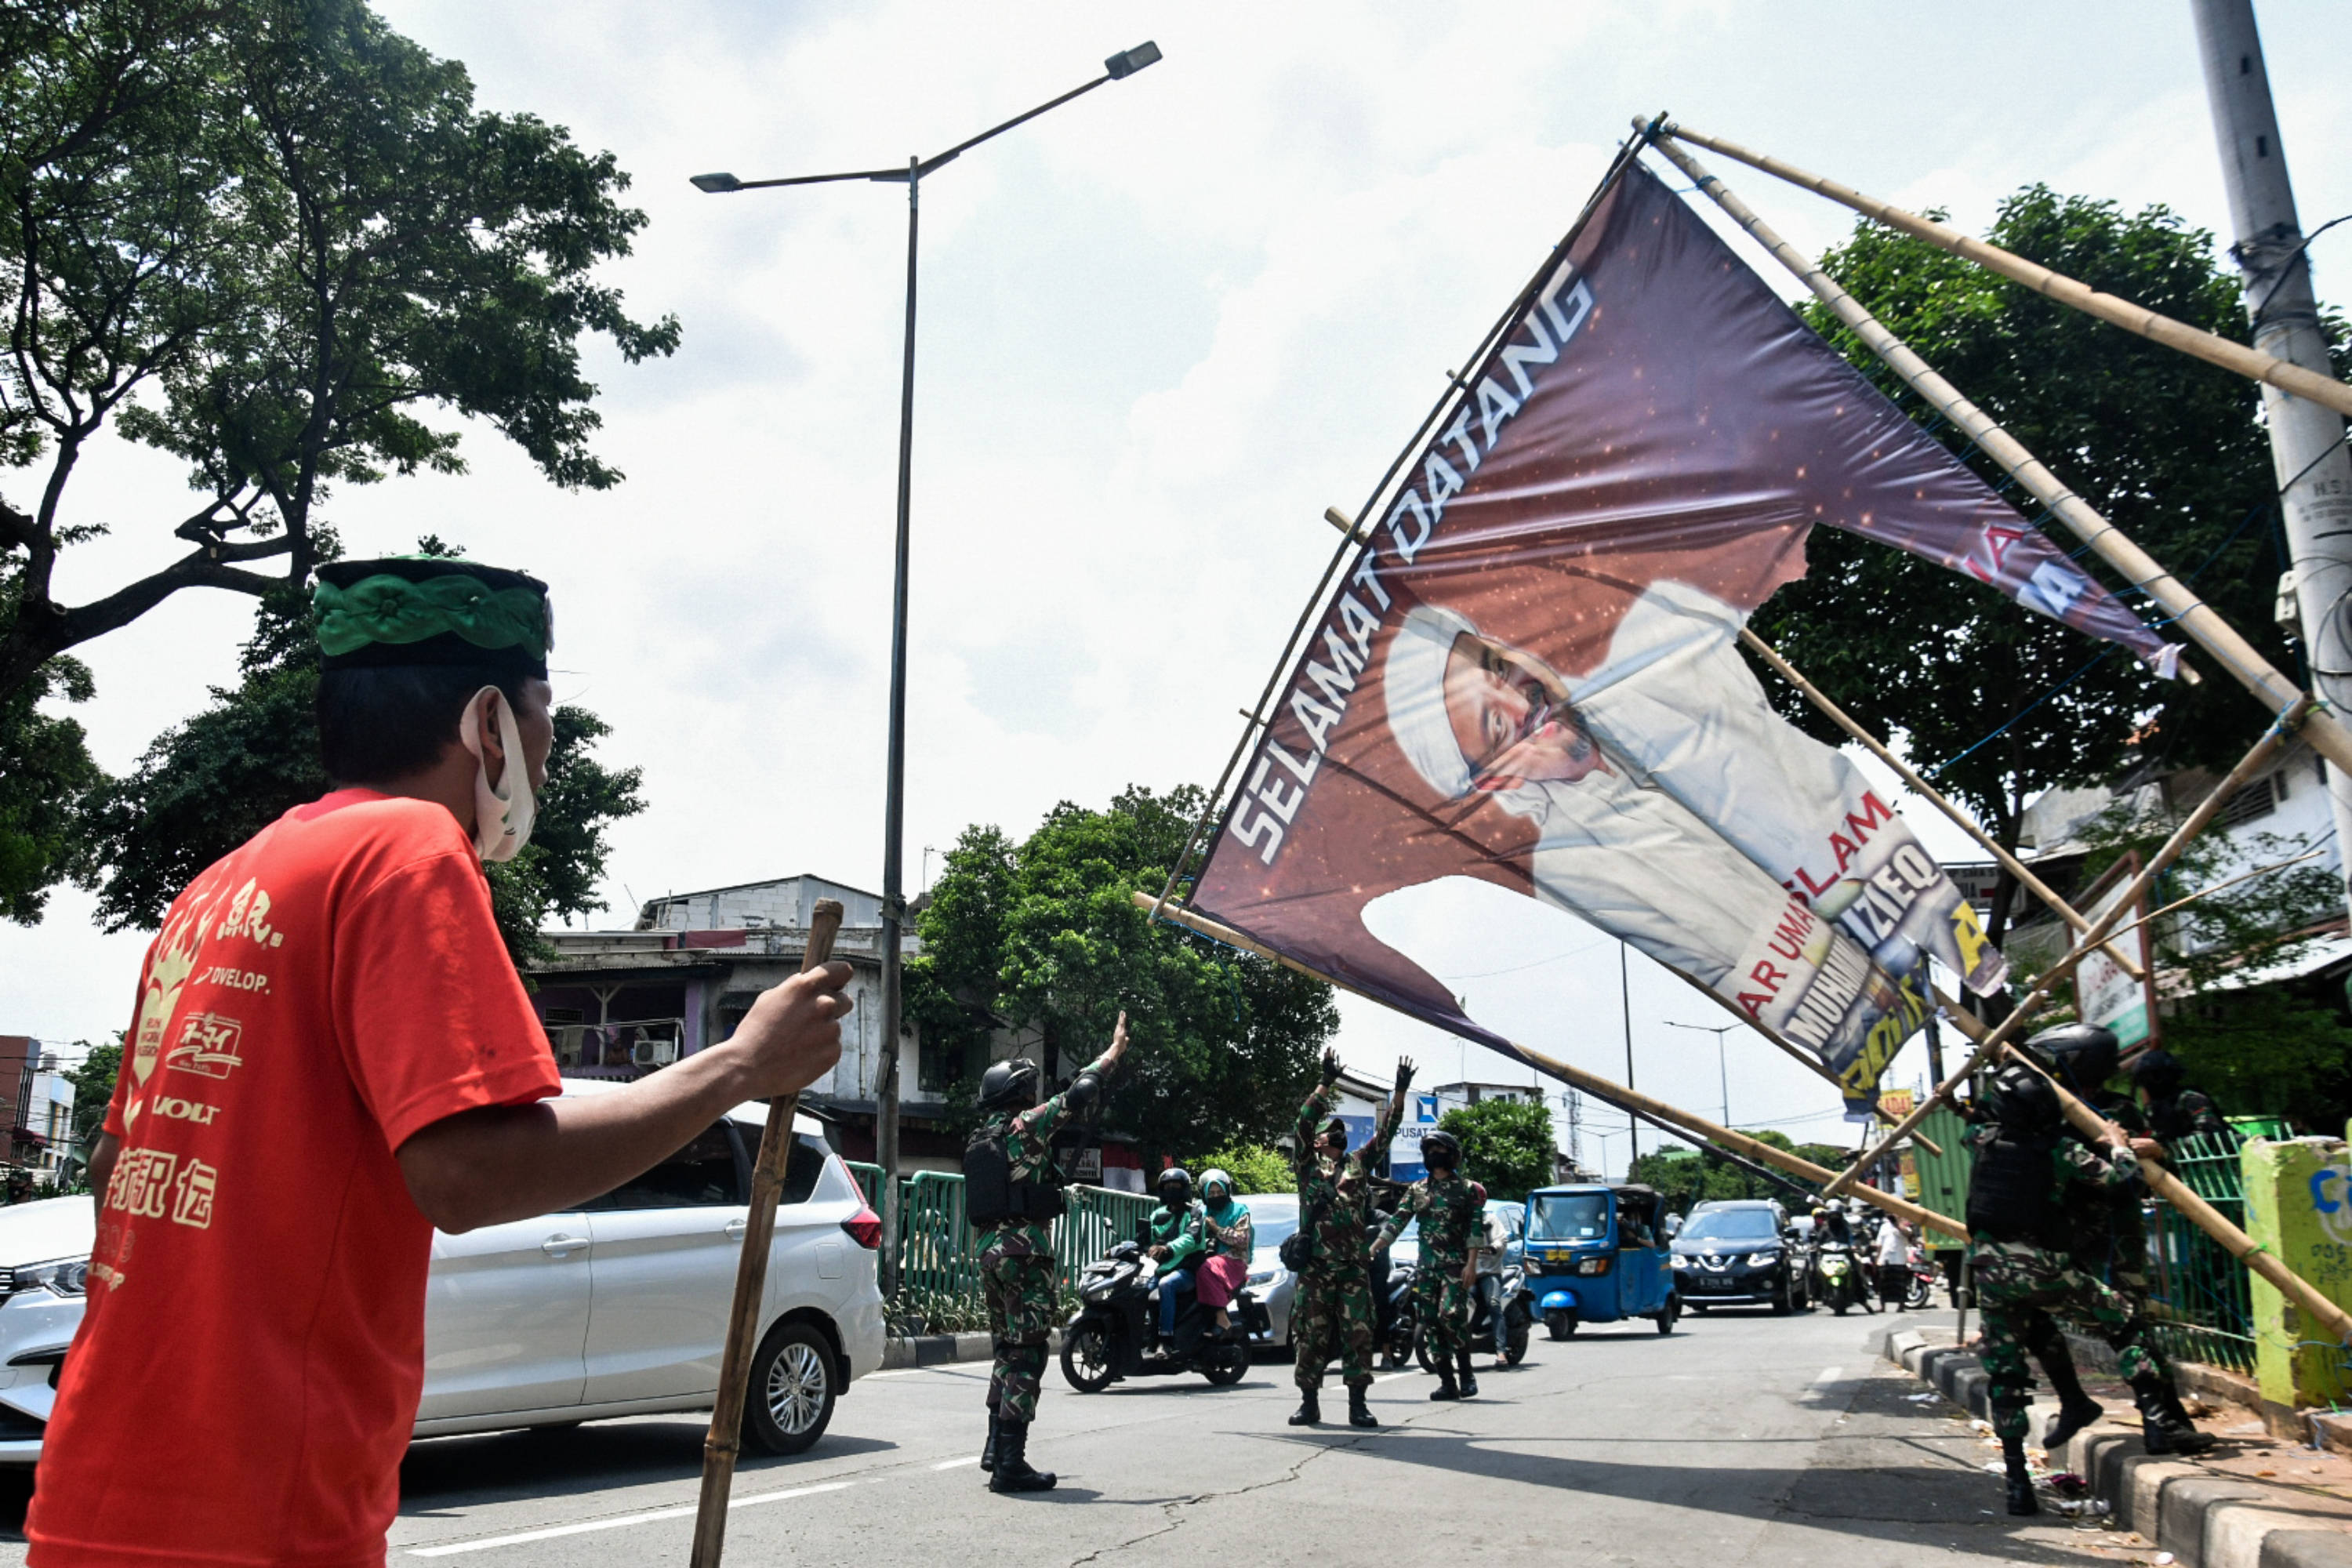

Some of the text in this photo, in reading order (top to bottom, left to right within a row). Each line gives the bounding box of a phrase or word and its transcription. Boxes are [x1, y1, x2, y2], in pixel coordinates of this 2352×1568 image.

[1229, 259, 1594, 865] SELAMAT DATANG
[1769, 892, 1817, 960] UMA
[151, 1094, 221, 1125] VOLT
[1395, 1127, 1427, 1138] PUSAT
